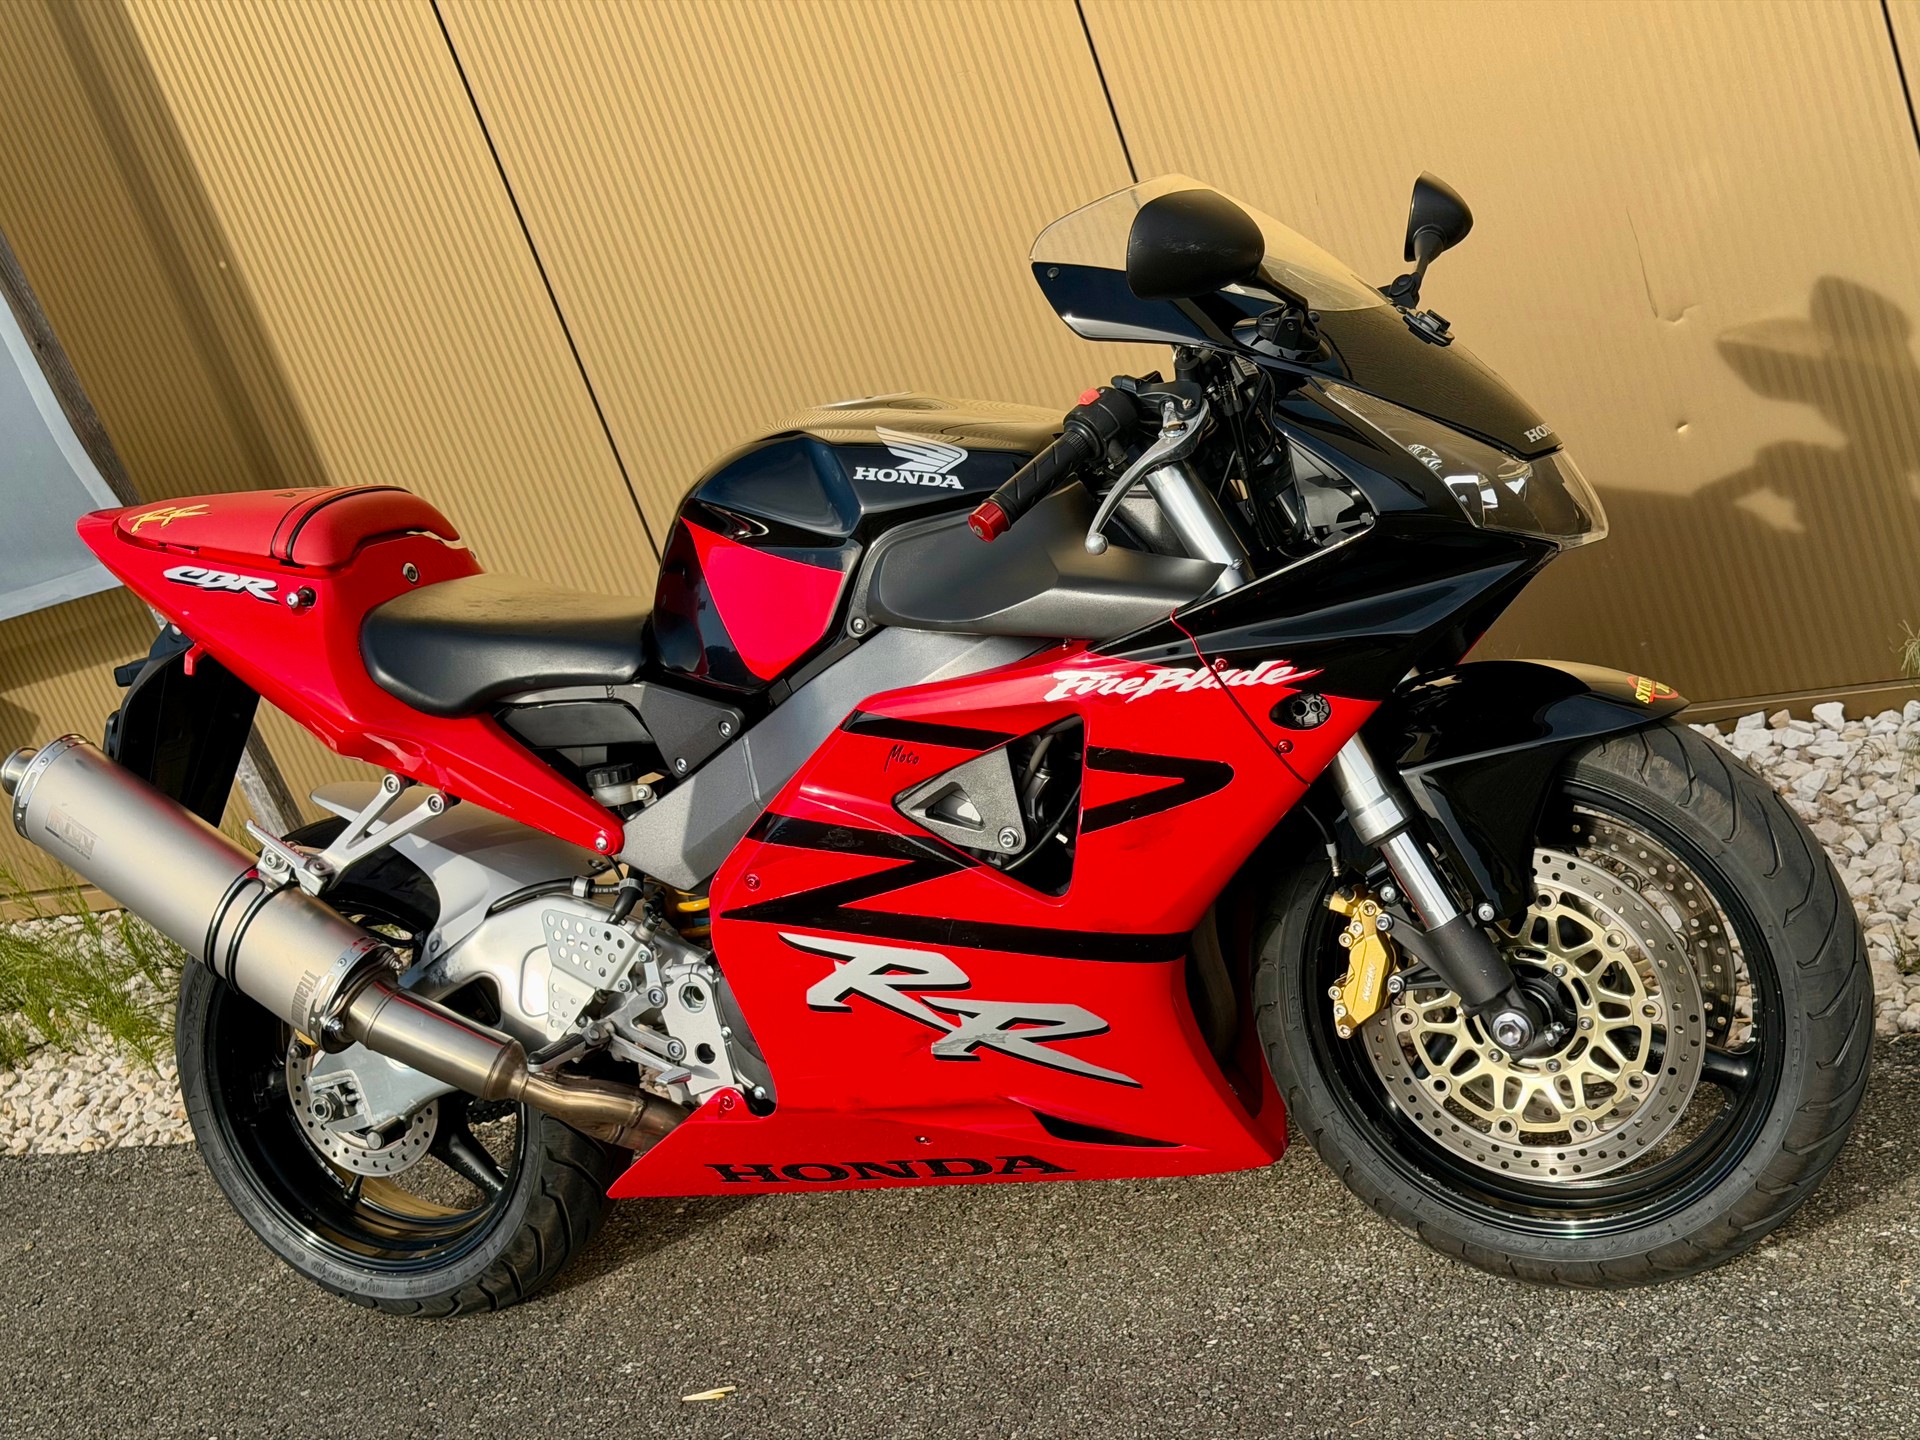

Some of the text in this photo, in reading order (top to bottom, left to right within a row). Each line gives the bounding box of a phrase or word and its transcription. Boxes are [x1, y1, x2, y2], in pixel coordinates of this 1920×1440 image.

[852, 466, 965, 490] HONDA
[162, 565, 282, 606] CBR
[777, 931, 1145, 1089] RR
[704, 1154, 1078, 1183] HONDA
